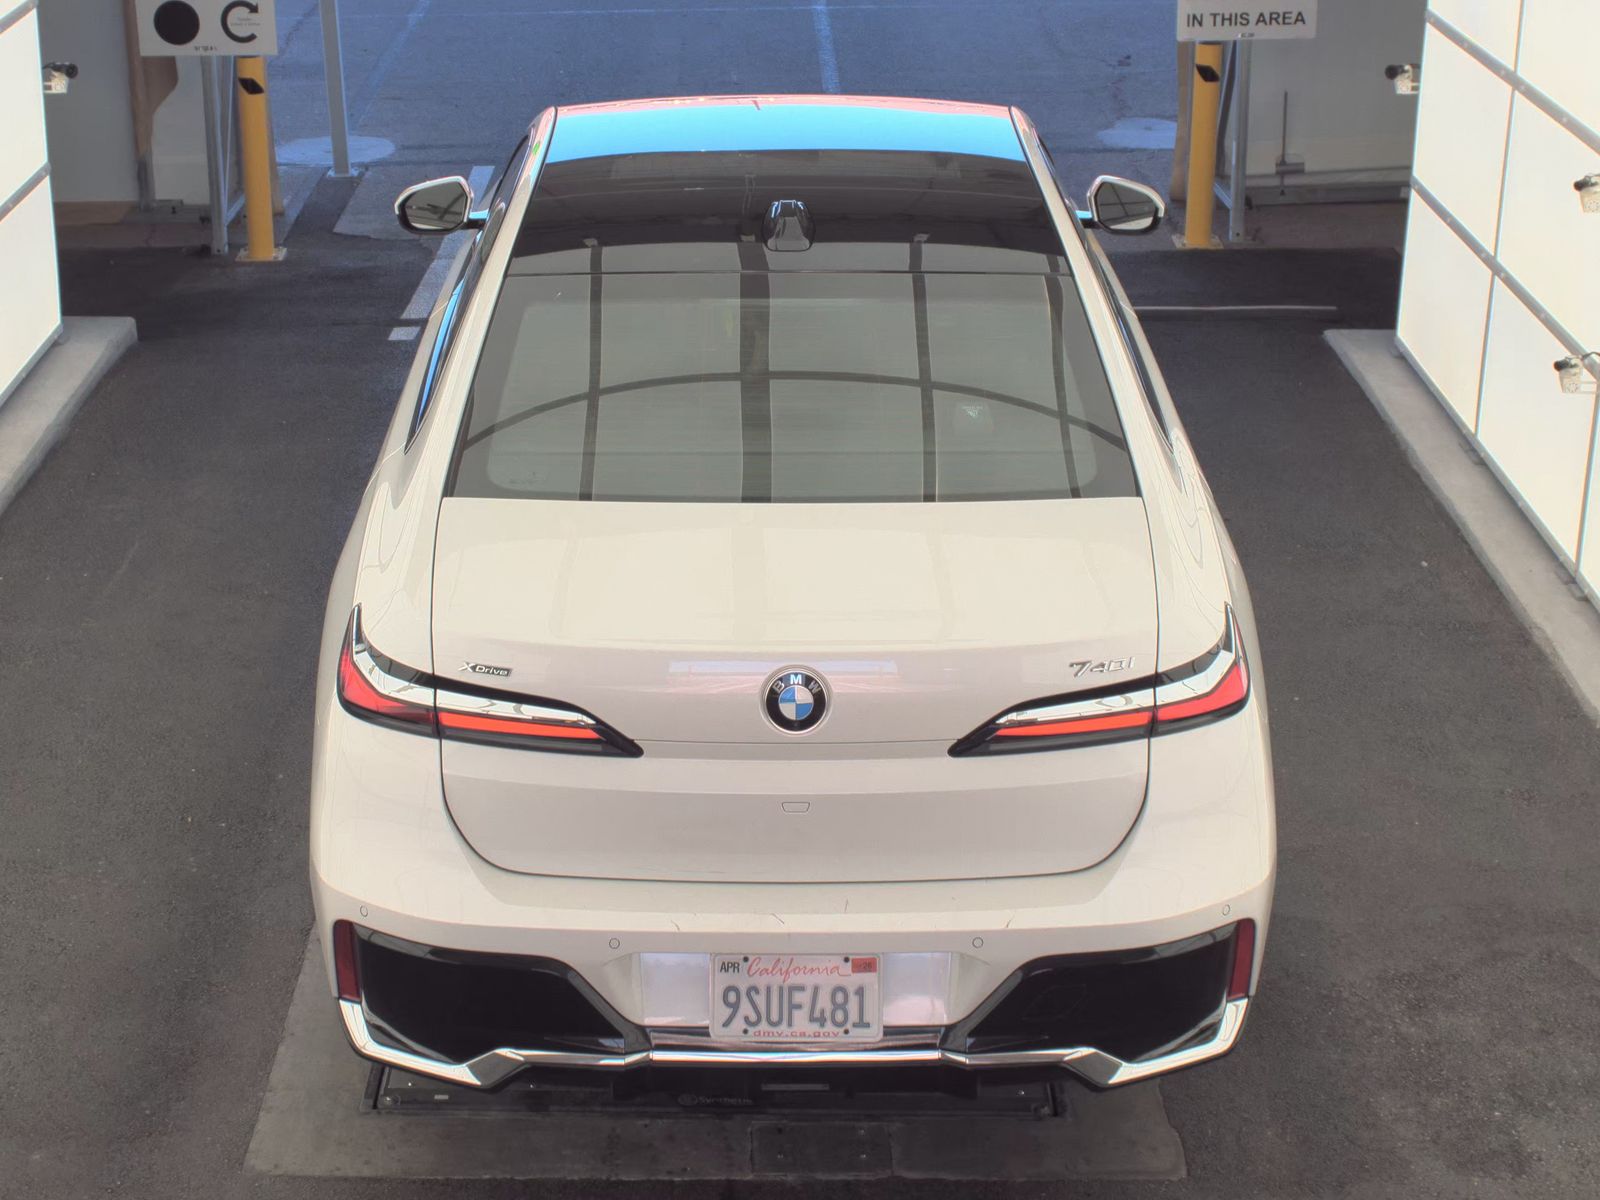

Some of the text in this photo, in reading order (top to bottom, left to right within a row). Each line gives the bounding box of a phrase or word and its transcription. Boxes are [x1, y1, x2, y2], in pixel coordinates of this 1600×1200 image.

[1186, 11, 1306, 27] IN THIS AREA
[1069, 656, 1135, 678] 740i
[771, 673, 822, 695] BMW
[719, 961, 740, 973] APR
[747, 956, 851, 983] California
[722, 984, 871, 1028] 9SUF481
[753, 1030, 840, 1038] dmv.ca.gov
